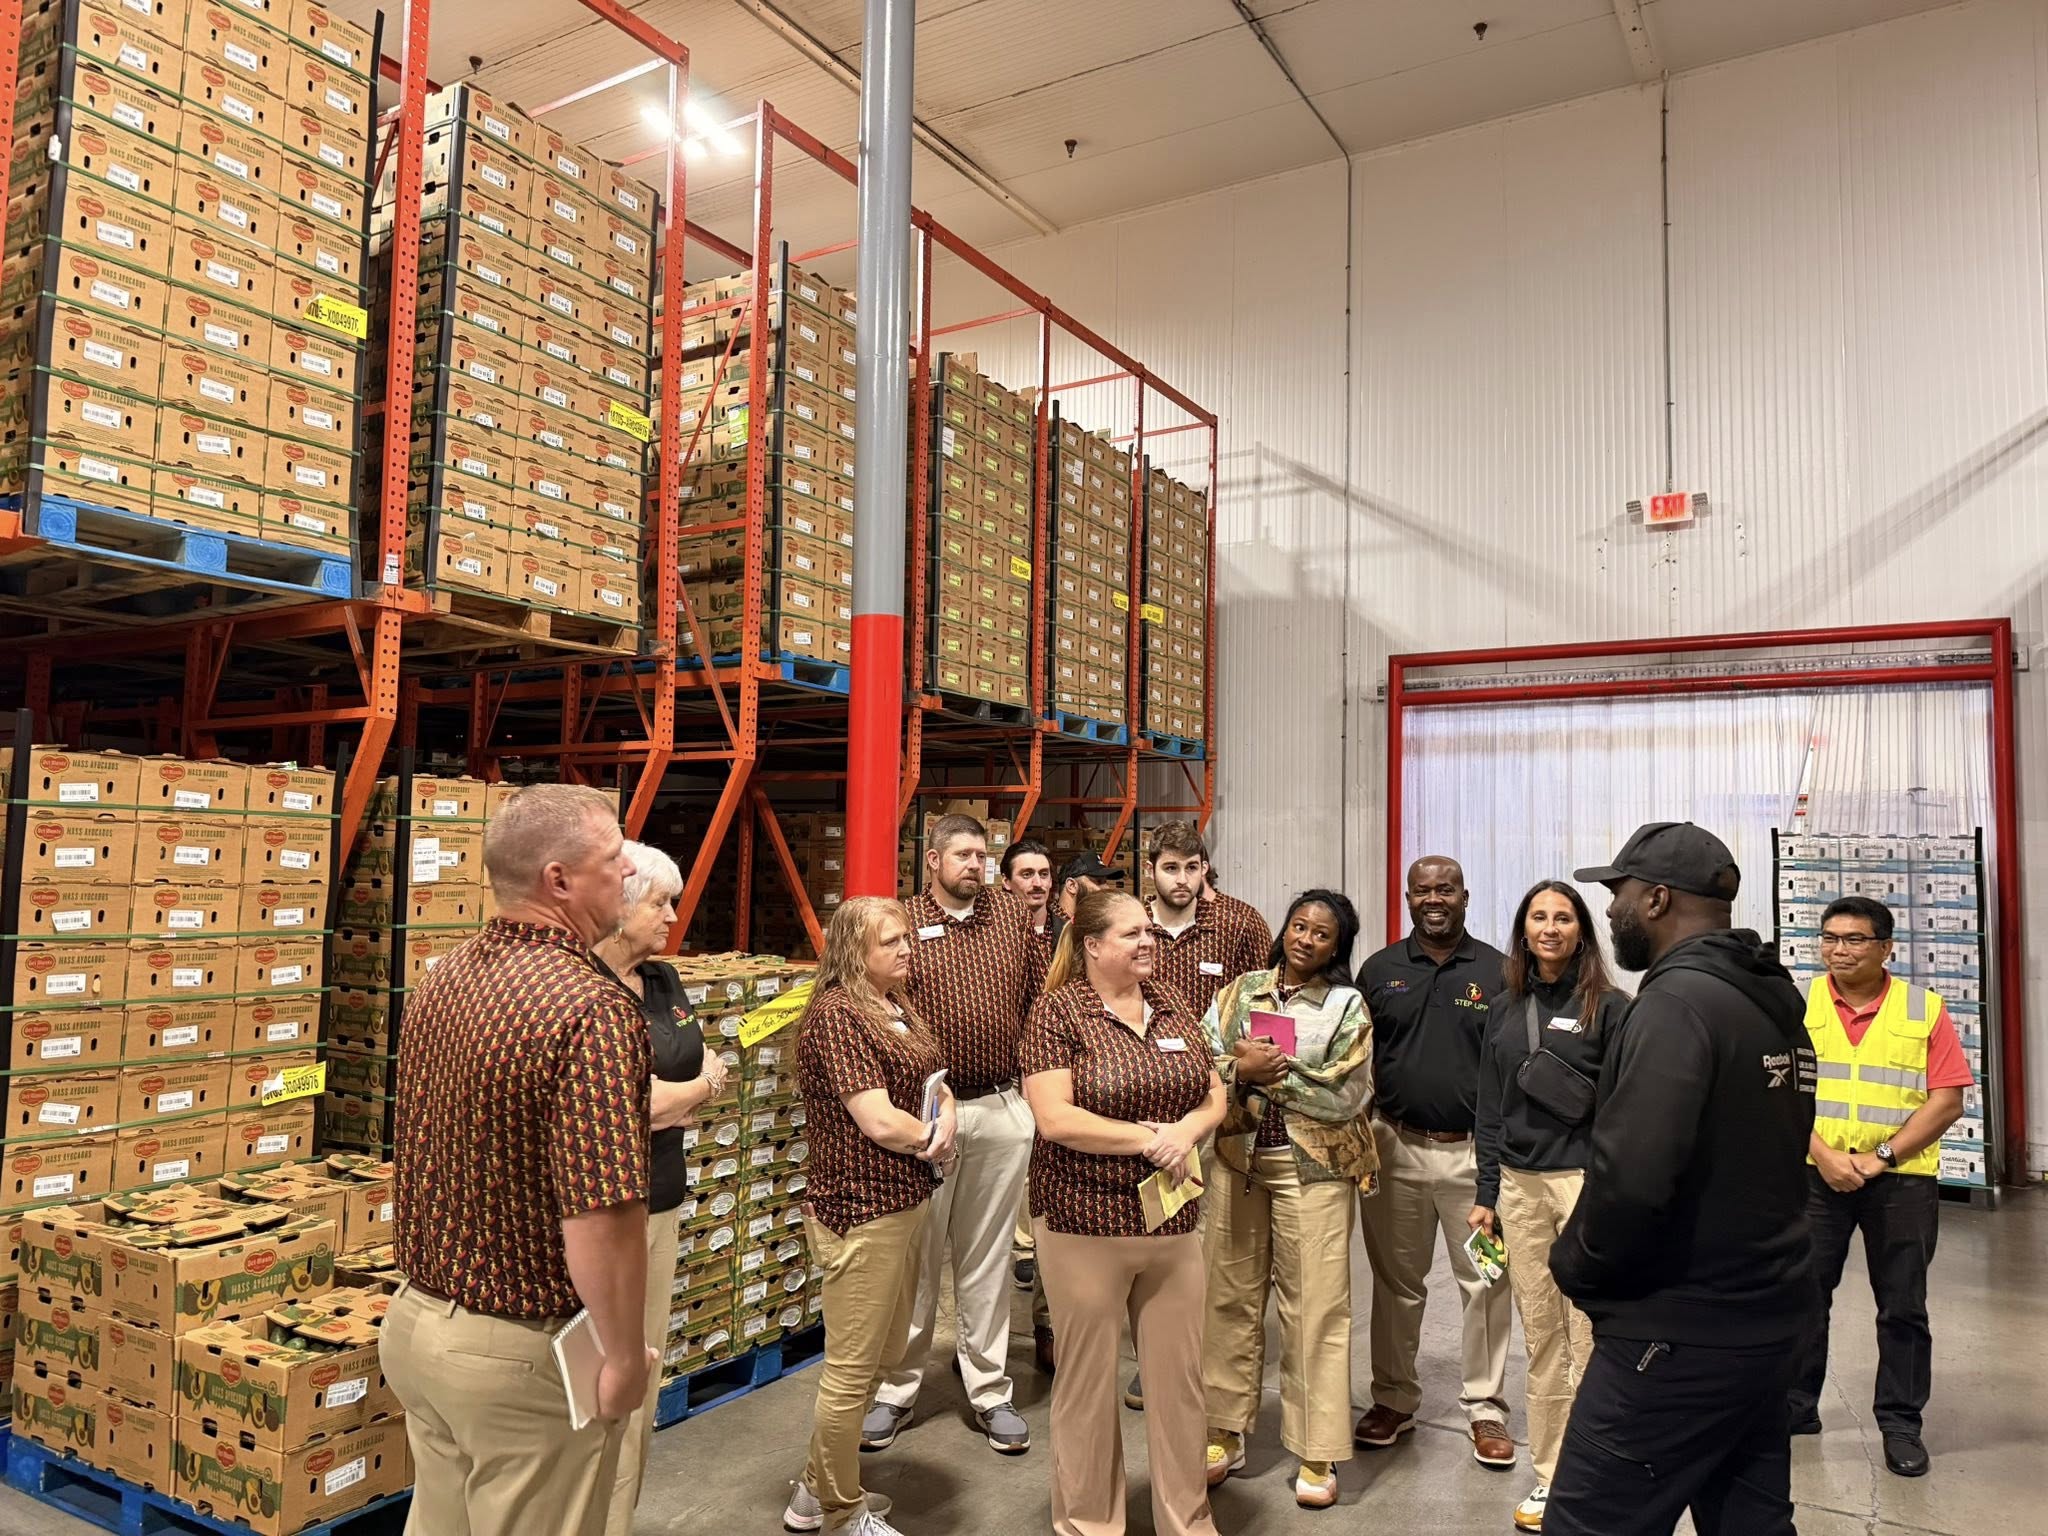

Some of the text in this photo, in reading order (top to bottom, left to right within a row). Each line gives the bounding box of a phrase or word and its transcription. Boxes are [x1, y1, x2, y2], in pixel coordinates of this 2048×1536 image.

[1651, 492, 1685, 520] EXIT
[1455, 998, 1472, 1007] STEP
[231, 1272, 286, 1295] HASS AVOCADOS
[343, 1360, 359, 1372] HASS
[338, 1442, 354, 1456] HASS
